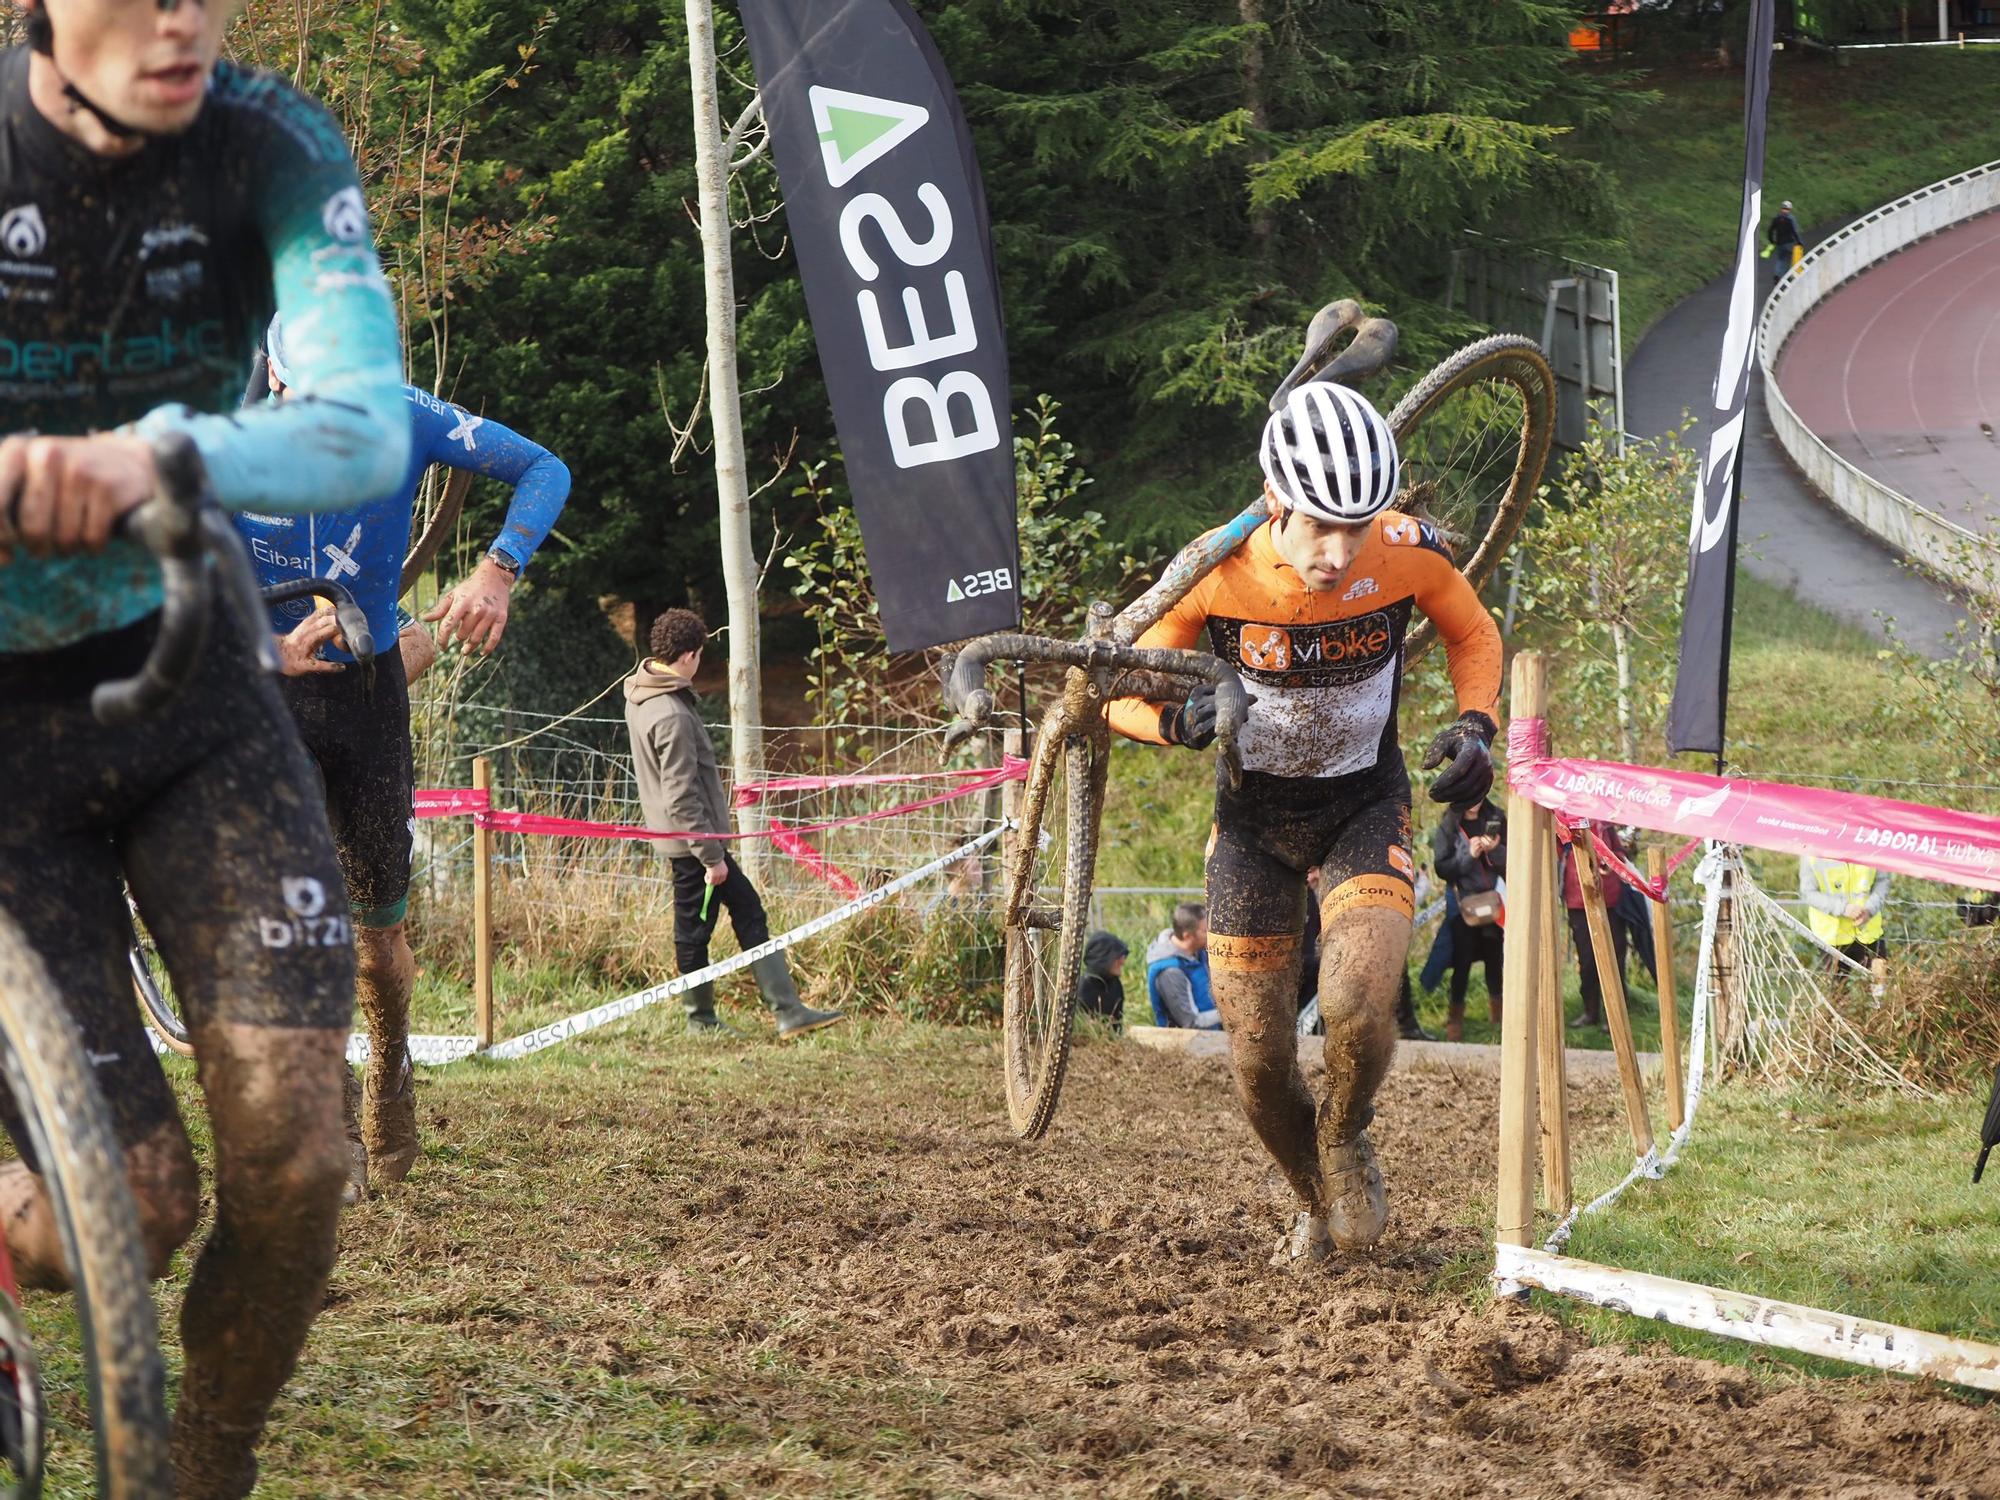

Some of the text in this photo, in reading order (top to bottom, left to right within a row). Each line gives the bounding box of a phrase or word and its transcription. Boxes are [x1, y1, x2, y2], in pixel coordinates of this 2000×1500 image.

[252, 538, 310, 570] Eibar
[1294, 628, 1389, 663] vibike
[1555, 774, 1624, 799] LABORAL
[1854, 826, 1939, 856] LABORAL
